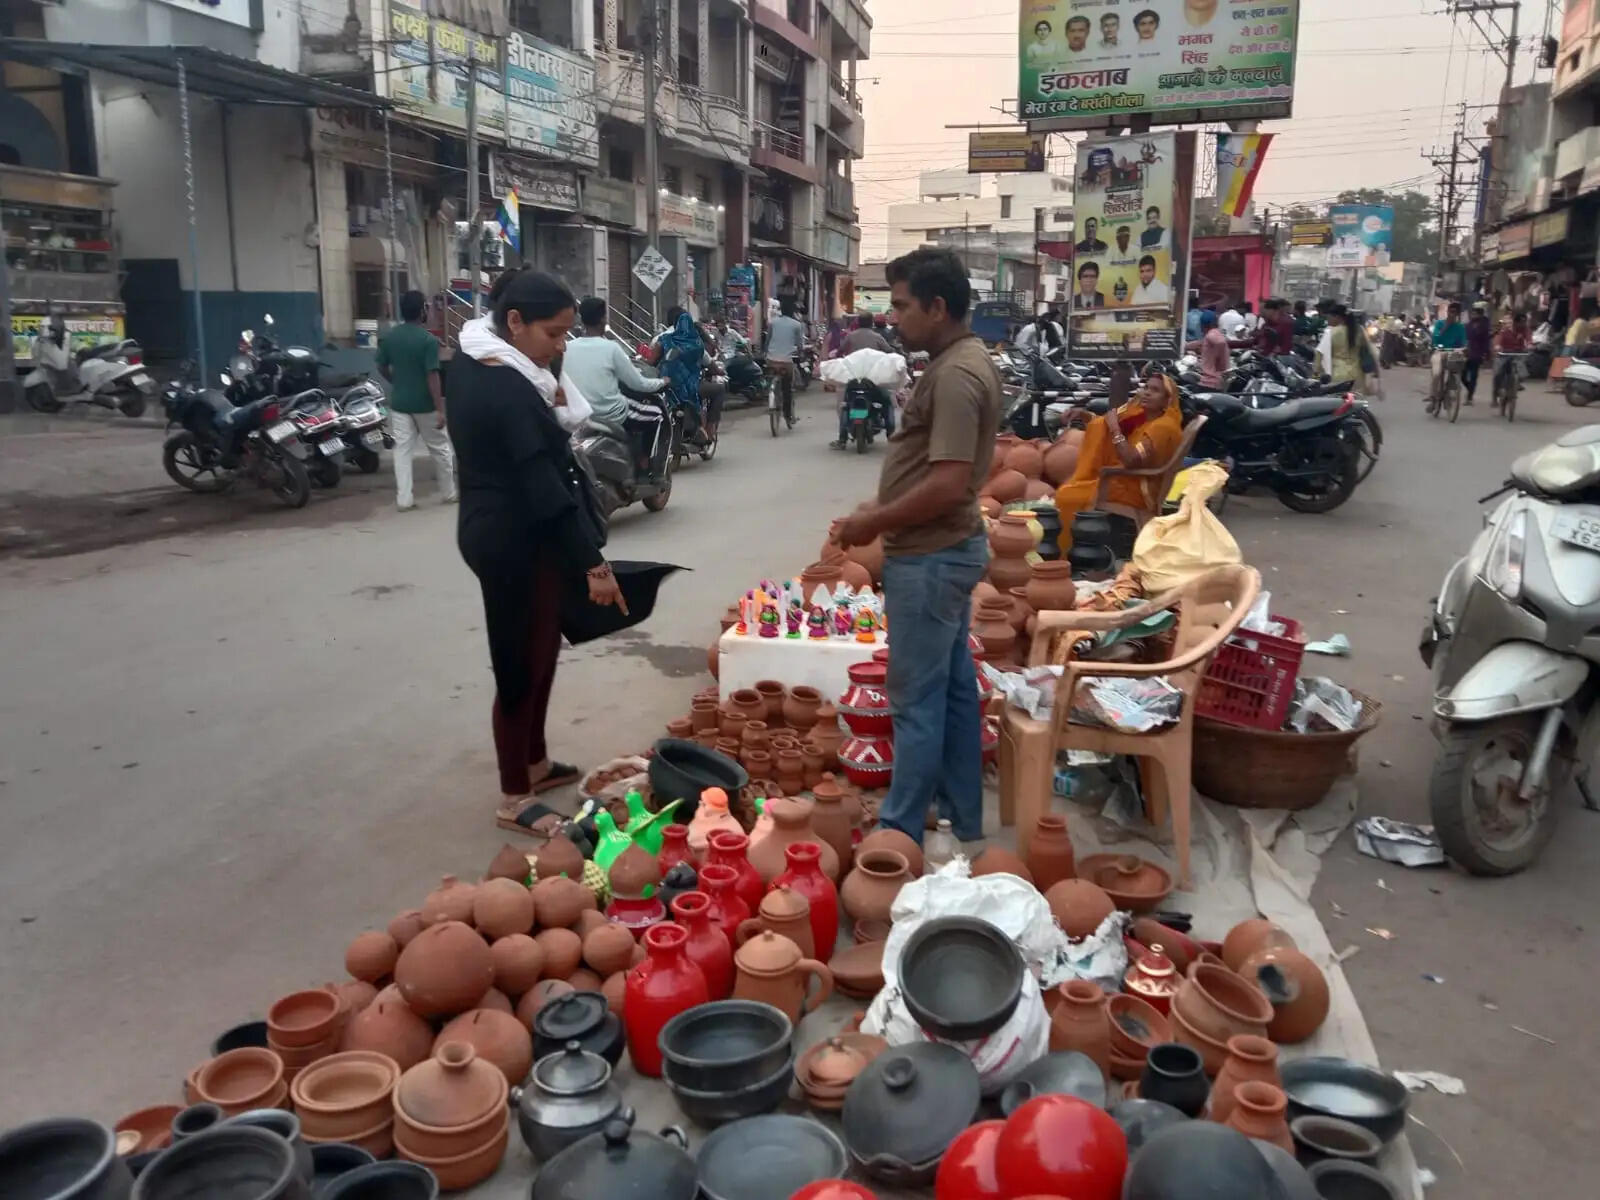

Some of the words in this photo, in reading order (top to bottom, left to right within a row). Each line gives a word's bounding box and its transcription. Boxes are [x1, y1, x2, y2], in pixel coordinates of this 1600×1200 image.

[1178, 33, 1213, 46] भगत
[1181, 49, 1209, 64] सिंह
[1040, 67, 1131, 94] इंकलाब
[1158, 67, 1205, 89] आजादी
[1208, 65, 1227, 84] के
[1025, 98, 1047, 114] मेरा
[1049, 99, 1066, 113] रंग
[1069, 96, 1079, 111] दे
[1080, 92, 1113, 110] बसंती
[1114, 92, 1144, 108] चोला
